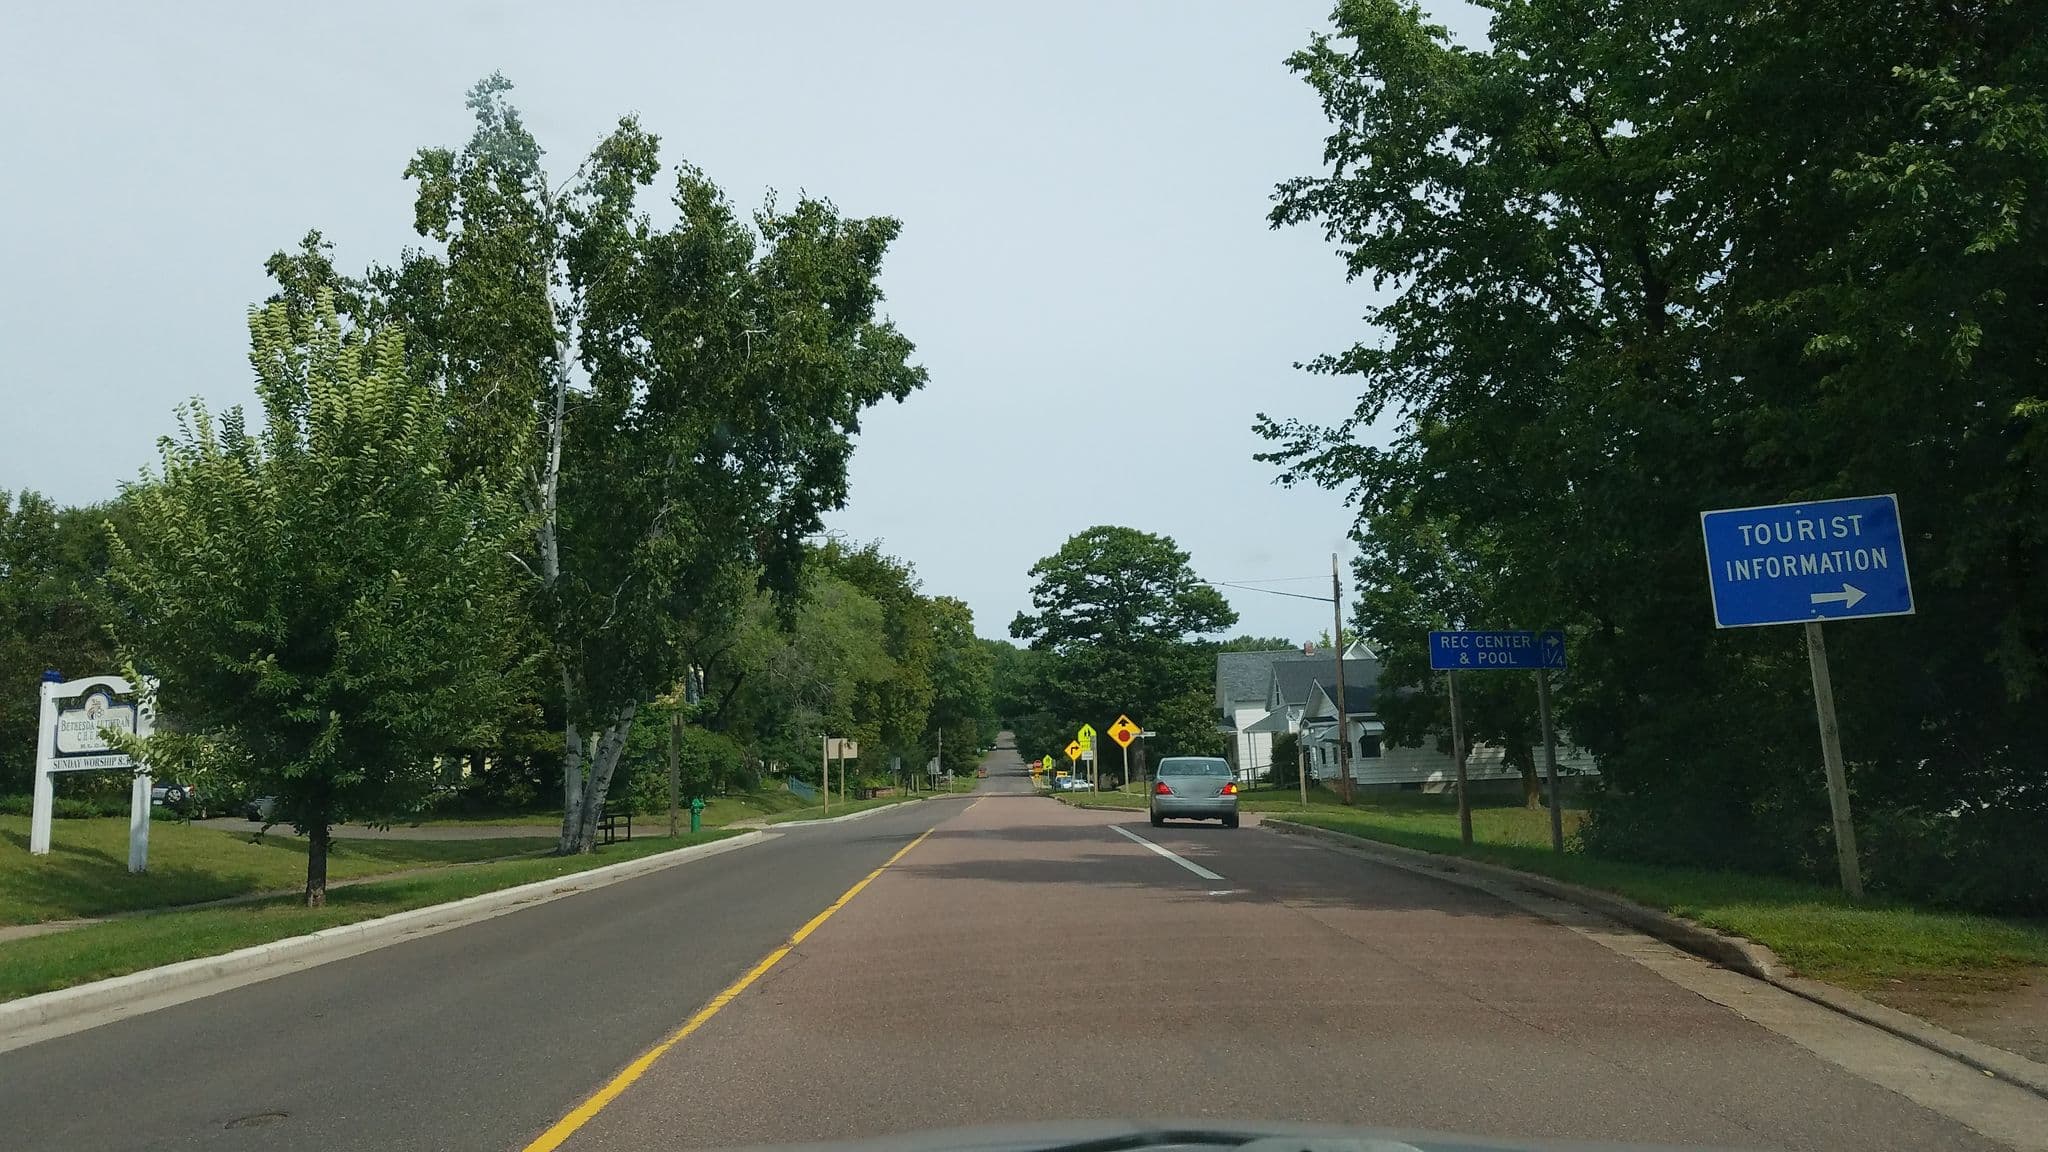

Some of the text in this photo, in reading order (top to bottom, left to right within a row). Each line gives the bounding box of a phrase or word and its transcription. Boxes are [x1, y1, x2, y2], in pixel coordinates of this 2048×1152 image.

[1738, 514, 1863, 546] TOURIST
[1726, 547, 1888, 582] INFORMATION
[1440, 635, 1531, 649] REC CENTER
[1459, 652, 1518, 665] & POOL
[53, 758, 81, 769] SUNDAY
[83, 755, 117, 768] WORSHIP
